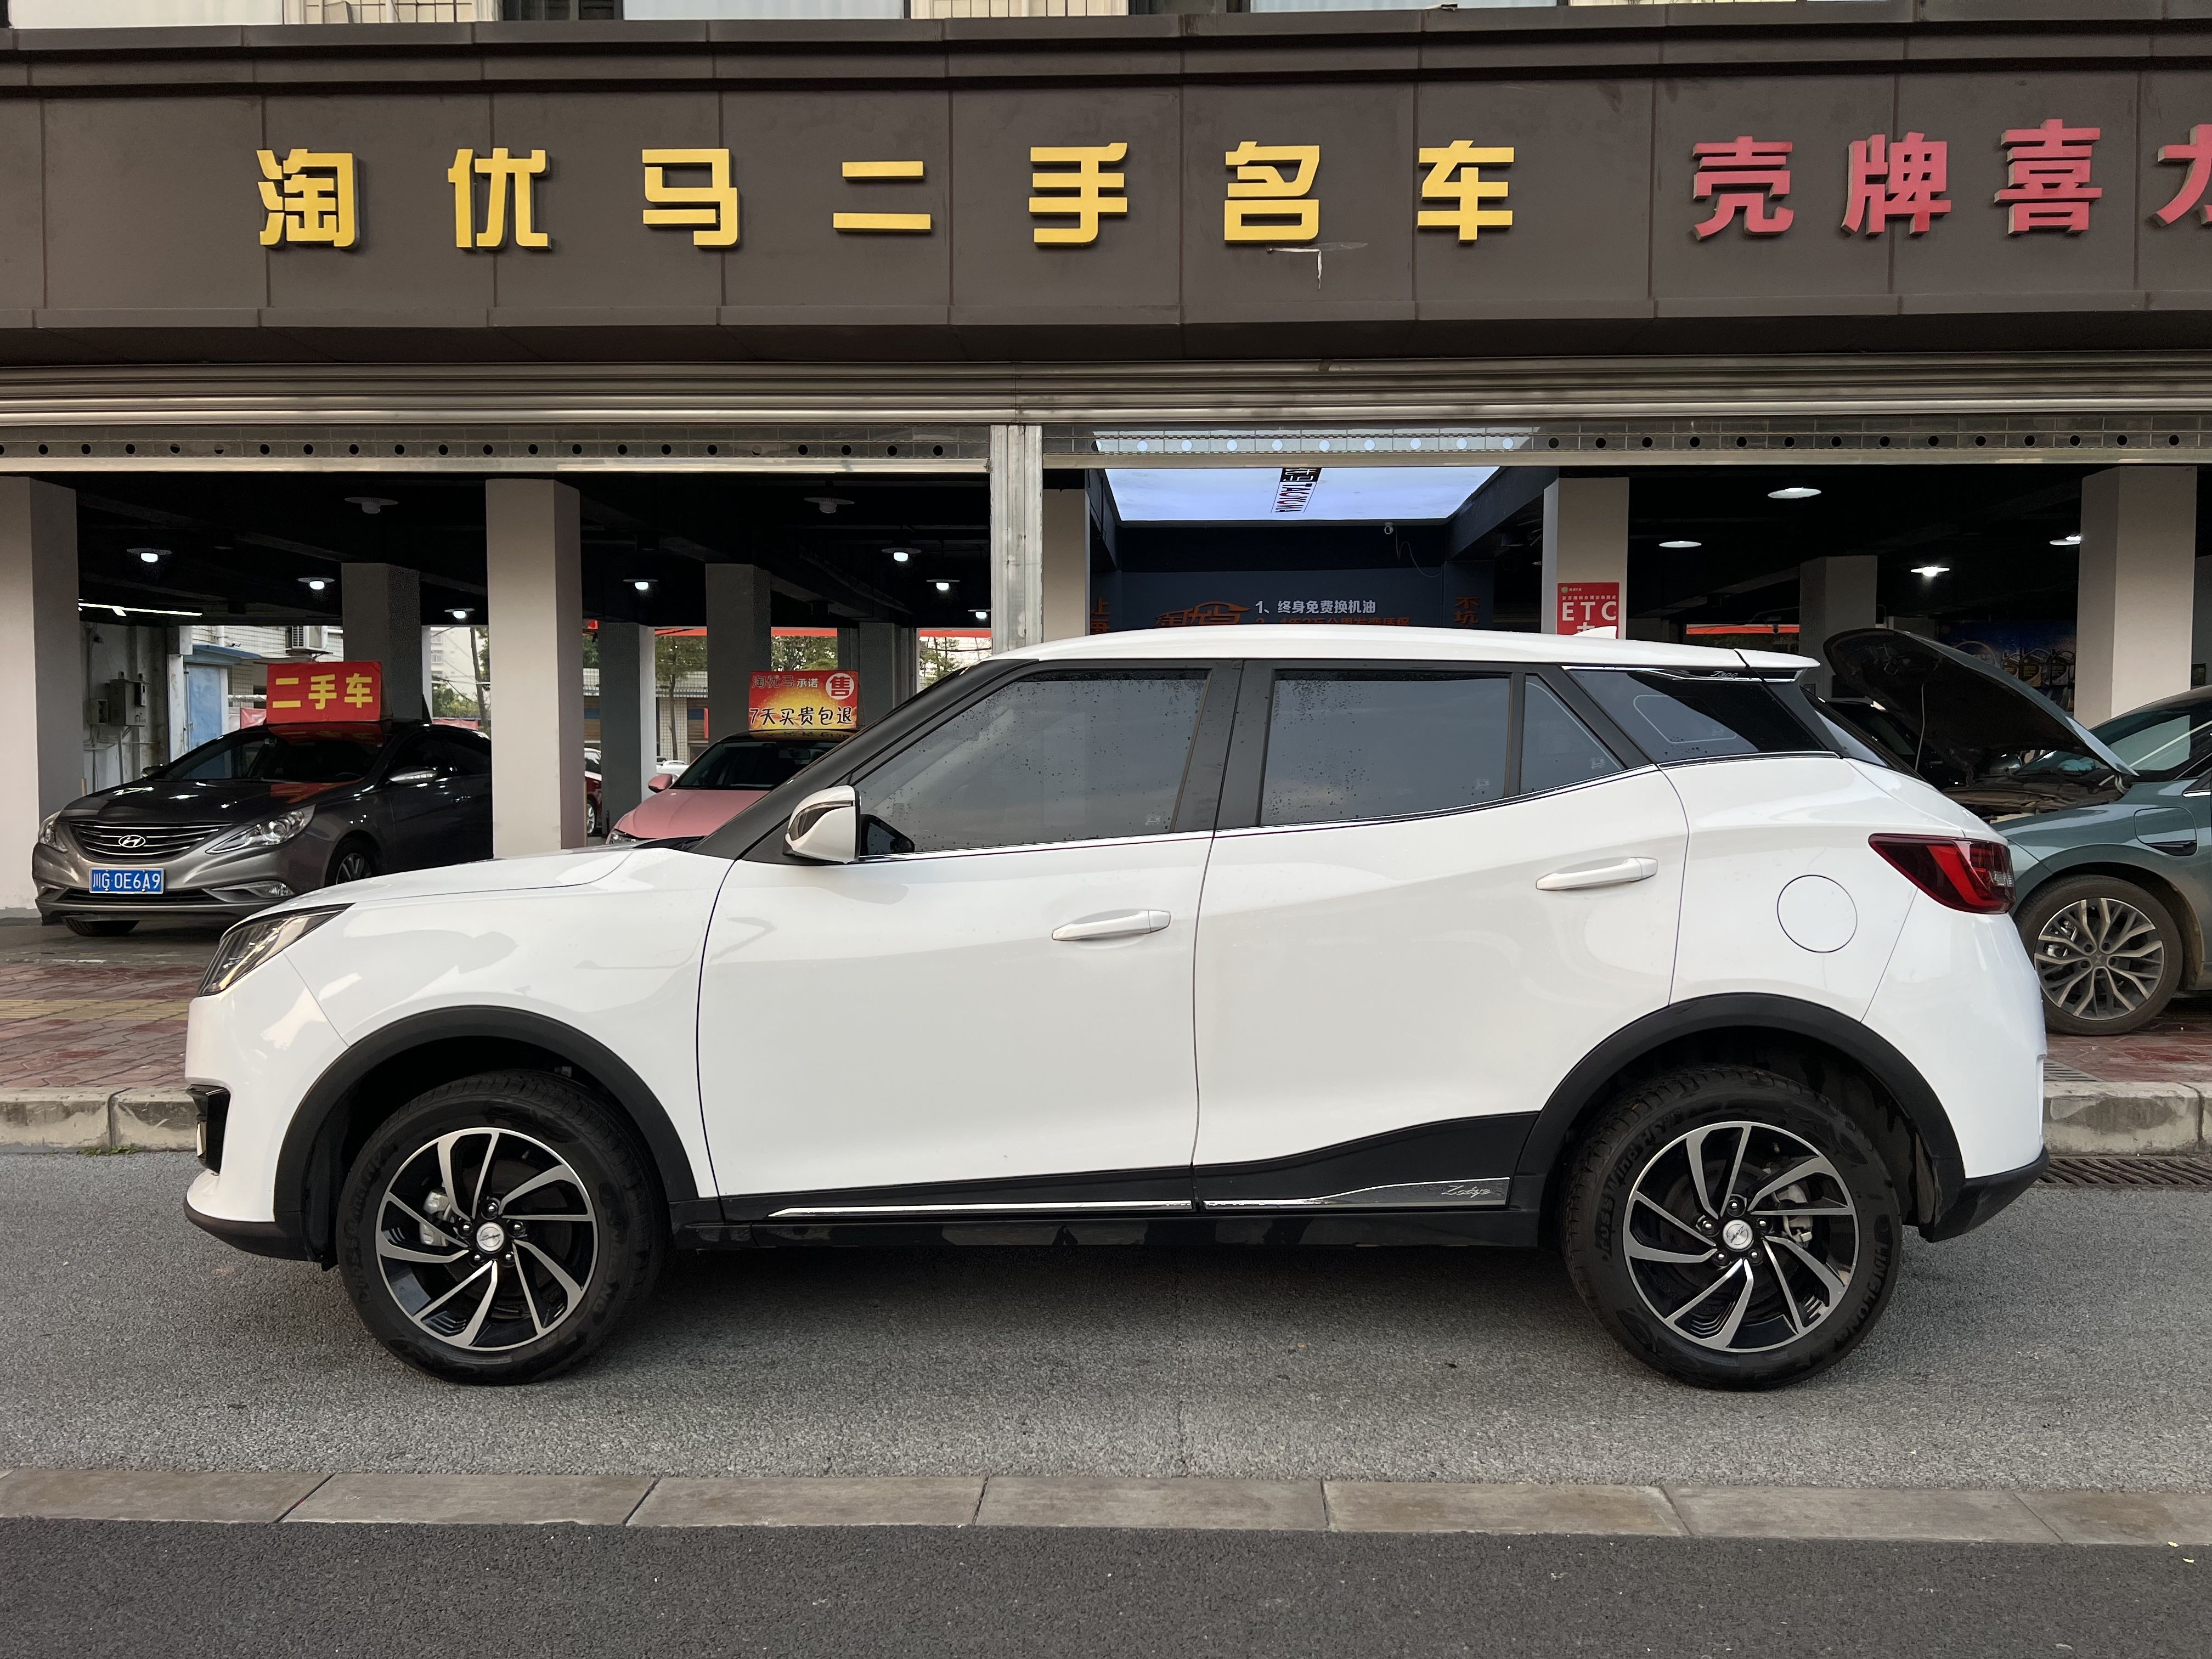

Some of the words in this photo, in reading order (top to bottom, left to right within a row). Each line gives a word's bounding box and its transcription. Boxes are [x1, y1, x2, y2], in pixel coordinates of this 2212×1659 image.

[256, 140, 1515, 250] 淘优马二手名车
[1562, 601, 1617, 621] ETC
[273, 674, 374, 710] 二手车
[828, 675, 851, 696] 售
[749, 706, 854, 726] 7天买贵包退
